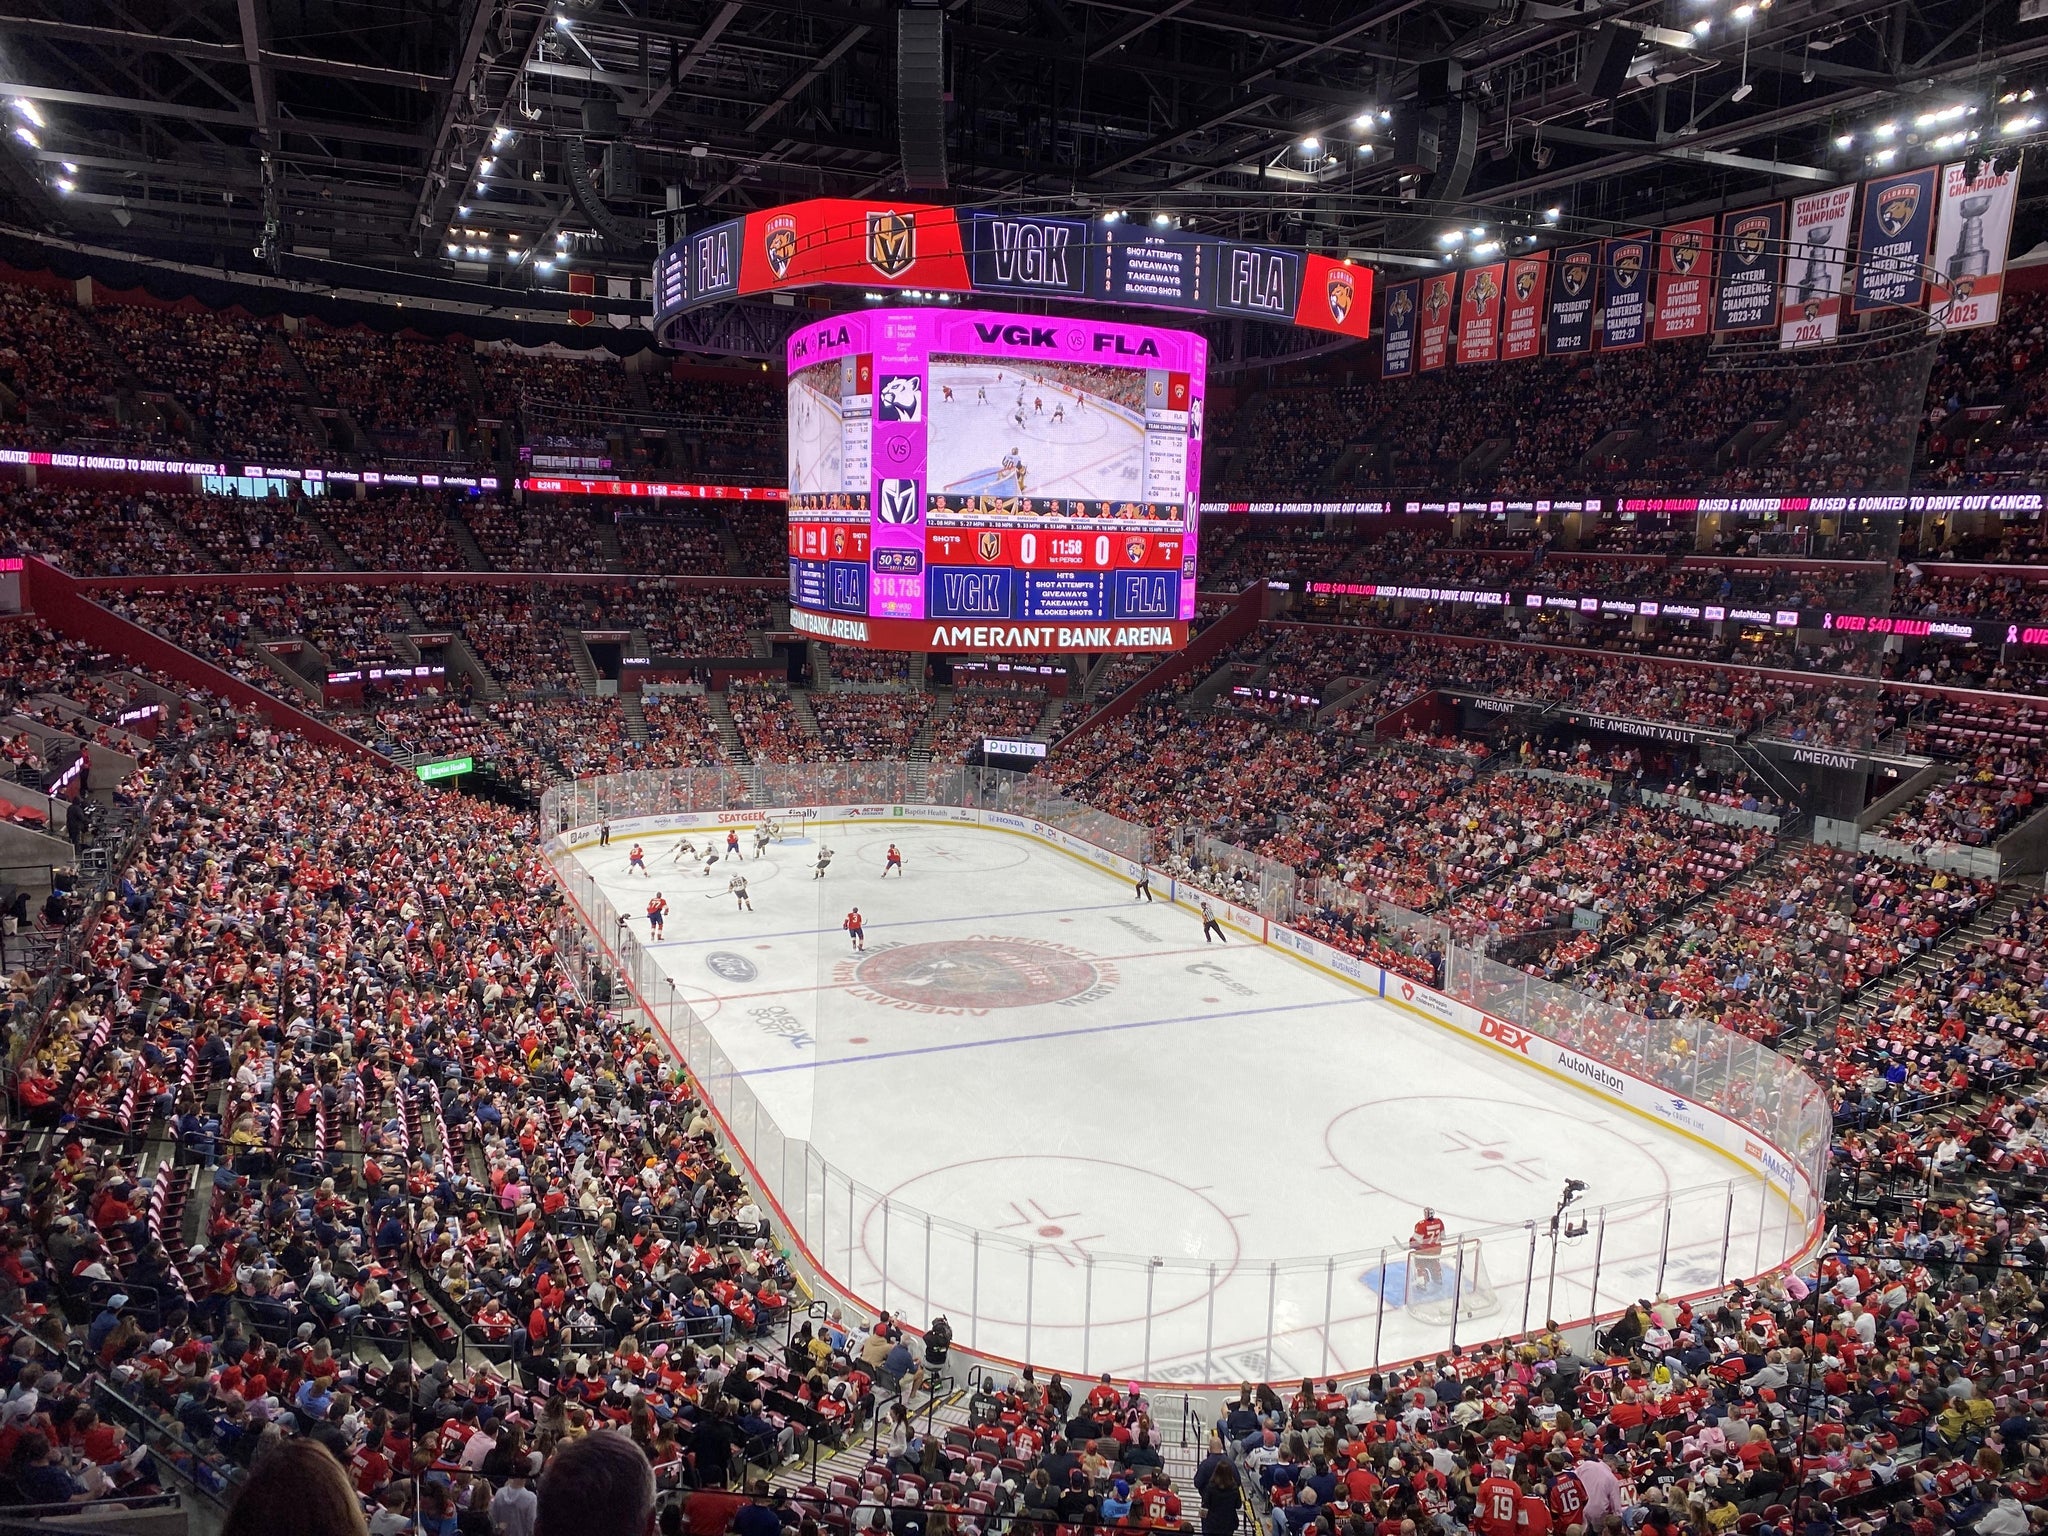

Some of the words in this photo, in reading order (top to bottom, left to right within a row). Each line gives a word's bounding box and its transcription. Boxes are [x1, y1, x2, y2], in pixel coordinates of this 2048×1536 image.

[1949, 172, 2009, 198] CHAMPIONS
[1880, 187, 1916, 202] FLORIDA
[1796, 196, 1831, 215] STANLEY
[1833, 191, 1850, 208] CUP
[1797, 206, 1846, 227] CHAMPIONS
[1736, 218, 1768, 233] FLORIDA
[992, 221, 1070, 285] VGK
[1126, 246, 1146, 256] SHOT
[1146, 249, 1183, 262] ATTEMPTS
[1614, 247, 1640, 259] FLORIDA
[1872, 240, 1912, 260] EASTERN
[698, 231, 730, 292] FLA
[1128, 259, 1180, 272] GIVEAWAYS
[1863, 254, 1919, 274] CONFERENCE
[1127, 271, 1181, 284] TAKEAWAYS
[1232, 250, 1285, 310] FLA
[1730, 268, 1766, 286] EASTERN
[1862, 269, 1915, 290] CHAMPIONS
[1125, 283, 1158, 294] BLOCKED
[1158, 287, 1181, 297] SHOTS
[1667, 279, 1700, 295] ATLANTIC
[1722, 280, 1773, 300] CONFERENCE
[1868, 286, 1906, 302] 2024-25
[1553, 299, 1592, 314] PRESIDENTS'
[1611, 292, 1640, 306] EASTERN
[1667, 292, 1699, 307] DIVISION
[1722, 294, 1771, 311] CHAMPIONS
[1511, 306, 1535, 320] ATLANTIC
[1606, 303, 1644, 317] CONFERENCE
[1660, 304, 1702, 321] CHAMPIONS
[1727, 310, 1762, 323] 2023-24
[1946, 303, 1979, 325] 2025
[1466, 318, 1492, 330] ATLANTIC
[1559, 311, 1584, 325] TROPHY
[1606, 314, 1642, 330] CHAMPIONS
[1665, 318, 1696, 331] 2023-24
[818, 325, 851, 351] FLA
[1507, 328, 1536, 343] CHAMPIONS
[1611, 328, 1636, 341] 2022-23
[1796, 323, 1822, 341] 2024
[973, 322, 1059, 349] VGK
[1071, 335, 1083, 346] VS
[1092, 331, 1160, 358] FLA
[1462, 336, 1494, 349] CHAMPIONS
[1557, 335, 1582, 348] 2021-22
[892, 444, 907, 455] VS
[52, 453, 78, 467] RAISED
[86, 456, 126, 470] DONATED
[126, 458, 139, 471] TO
[139, 459, 166, 472] DRIVE
[166, 461, 184, 474] OUT
[184, 462, 218, 476] CANCER.
[647, 485, 668, 496] 11:58
[1200, 503, 1230, 512] DONATED
[1249, 503, 1274, 512] RAISED
[1282, 503, 1312, 512] DONATED
[1312, 503, 1322, 512] TO
[1322, 503, 1342, 512] DRIVE
[1342, 503, 1356, 512] OUT
[1356, 503, 1384, 512] CANCER.
[1553, 501, 1582, 510] AutoNation
[1625, 500, 1646, 511] OVER
[1647, 499, 1663, 512] $40
[1664, 499, 1698, 511] MILLION
[1698, 499, 1730, 512] RAISED
[1739, 498, 1781, 512] DONATED
[1809, 497, 1847, 511] RAISED
[1848, 497, 1857, 510] &
[1858, 496, 1908, 511] DONATED
[1910, 497, 1925, 511] TO
[1926, 495, 1962, 511] DRIVE
[1963, 495, 1990, 510] OUT
[1990, 494, 2043, 510] CANCER.
[932, 535, 961, 543] SHOTS
[1158, 541, 1179, 549] SHOTS
[943, 543, 950, 556] 1
[1020, 533, 1037, 565] 0
[1095, 535, 1110, 566] 0
[1051, 539, 1083, 555] 11:58
[879, 554, 892, 565] 50
[903, 555, 916, 567] 50
[1059, 556, 1084, 564] PERIOD
[1165, 549, 1171, 561] 2
[1056, 572, 1075, 580] HITS
[834, 567, 860, 606] FLA
[873, 577, 921, 598] $18,735
[943, 573, 1001, 612] VGK
[1035, 581, 1056, 589] SHOT
[1056, 581, 1094, 589] ATTEMPTS
[1042, 590, 1088, 599] GIVEAWAYS
[1125, 576, 1168, 613] FLA
[1313, 582, 1331, 593] OVER
[1331, 583, 1346, 594] $40
[1346, 584, 1376, 596] MILLION
[1376, 585, 1396, 597] RAISED
[1403, 587, 1430, 599] DONATED
[1430, 588, 1439, 599] TO
[1439, 589, 1459, 601] DRIVE
[1459, 590, 1473, 602] OUT
[1474, 591, 1502, 604] CANCER.
[1040, 599, 1089, 607] TAKEAWAYS
[1545, 596, 1577, 608] AutoNation
[1602, 600, 1636, 613] AutoNation
[1034, 608, 1069, 617] BLOCKED
[1069, 609, 1094, 617] SHOTS
[1662, 604, 1700, 618] AutoNation
[1729, 608, 1771, 624] AutoNation
[809, 615, 831, 637] BANK
[831, 618, 866, 642] ARENA
[1835, 615, 1865, 631] OVER
[1867, 617, 1892, 632] $40
[931, 626, 1055, 649] AMERANT
[1057, 627, 1116, 648] BANK
[1114, 626, 1173, 647] ARENA
[1474, 699, 1515, 714] AMERANT
[1588, 717, 1605, 729] THE
[1607, 721, 1656, 739] AMERANT
[1658, 728, 1696, 744] VAULT
[990, 741, 1036, 755] Publix
[1793, 749, 1858, 770] AMERANT
[718, 811, 767, 824] SEATGEEK
[905, 808, 926, 817] Baptist
[927, 808, 948, 817] Health
[996, 816, 1025, 828] HONDA
[650, 900, 662, 909] 77
[852, 915, 858, 923] 3
[1331, 951, 1362, 967] COMCAST
[1331, 960, 1362, 979] BUSINESS
[1479, 1016, 1533, 1055] DEX
[1557, 1051, 1624, 1092] AutoNation
[1493, 1496, 1514, 1521] 19
[1559, 1489, 1581, 1513] 16
